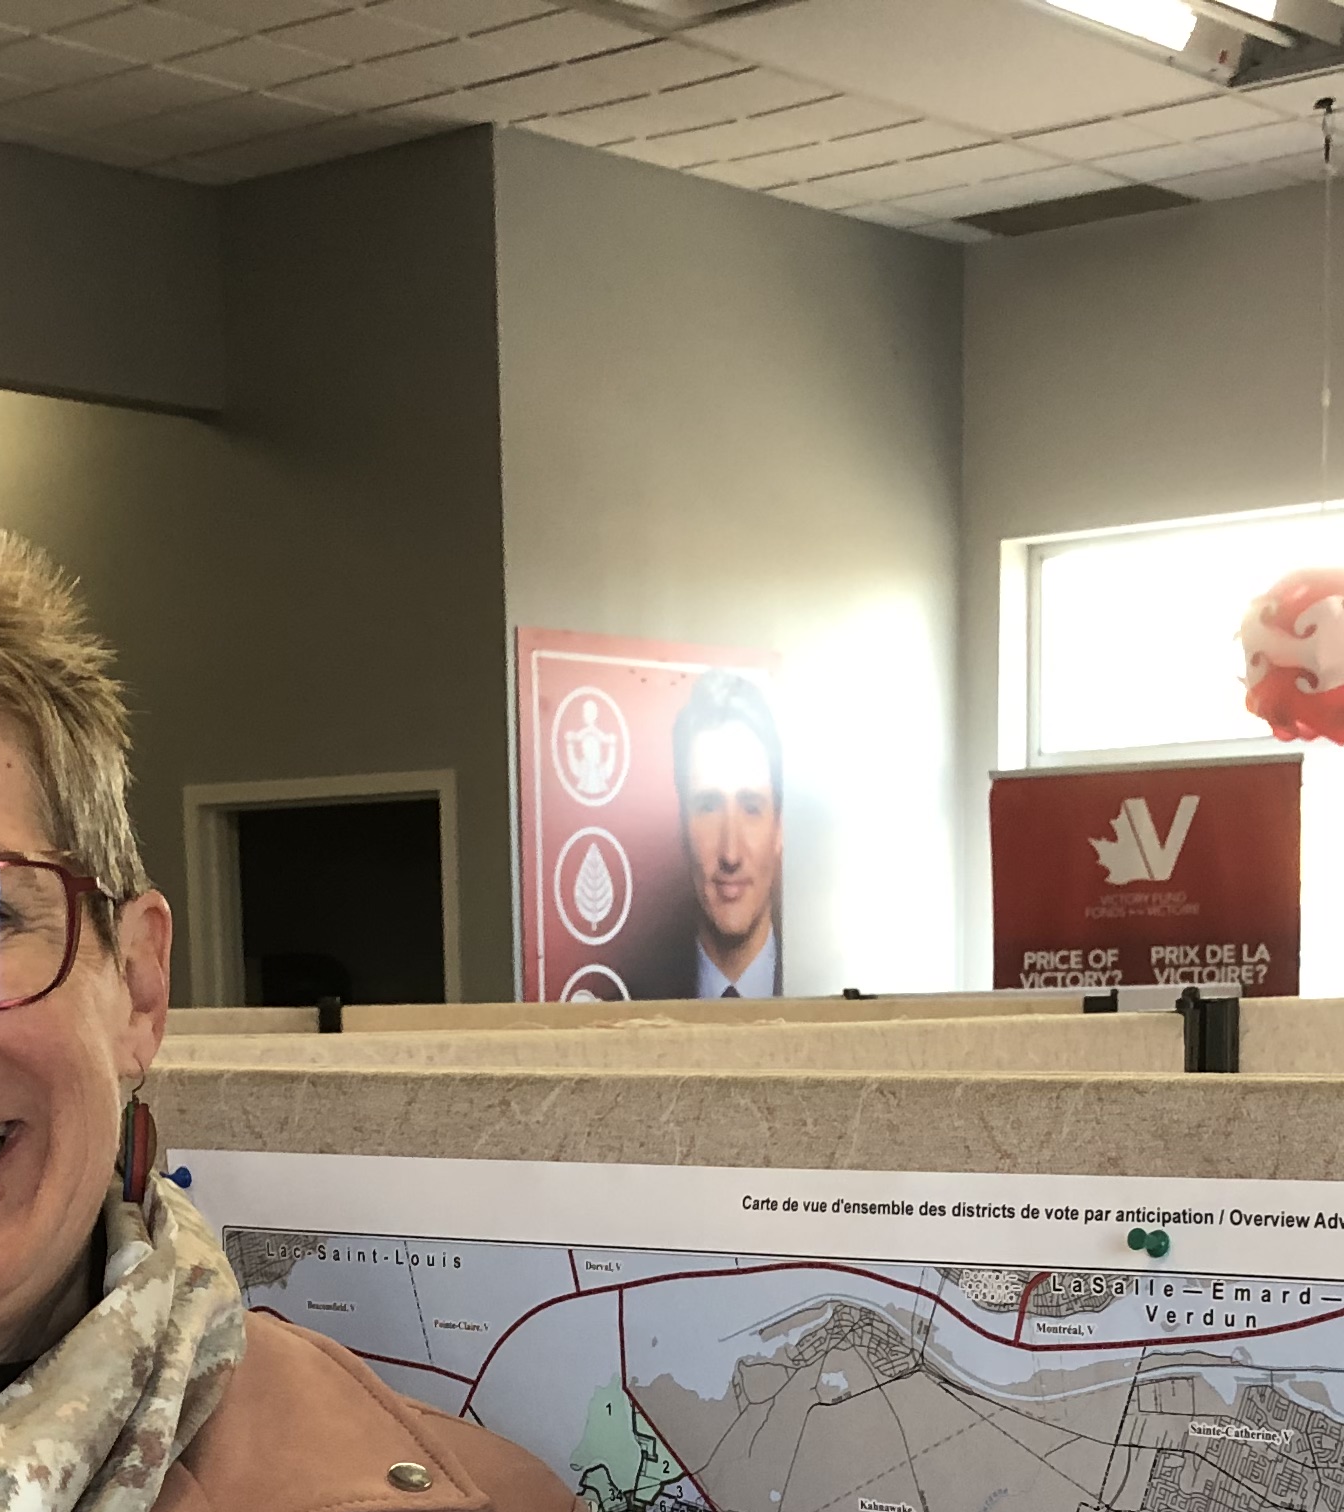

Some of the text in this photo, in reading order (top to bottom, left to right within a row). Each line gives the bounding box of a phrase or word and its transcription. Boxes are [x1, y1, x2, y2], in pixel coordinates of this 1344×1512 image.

[1023, 949, 1119, 971] PRICE OF
[1151, 943, 1271, 965] PRIX DE LA
[1154, 964, 1267, 986] VICTOIRE?
[742, 1195, 779, 1213] Carte
[782, 1196, 798, 1212] de
[803, 1202, 827, 1214] vue
[832, 1198, 914, 1216] d'ensemble
[918, 1201, 946, 1217] des
[952, 1202, 1016, 1220] districts
[1020, 1204, 1040, 1220] de
[1045, 1206, 1079, 1222] vote
[1084, 1207, 1111, 1225] par
[1115, 1205, 1214, 1227] anticipation
[1229, 1209, 1311, 1229] Overview
[1145, 1305, 1258, 1329] Verdun
[605, 1402, 613, 1416] 1
[662, 1459, 671, 1475] 2
